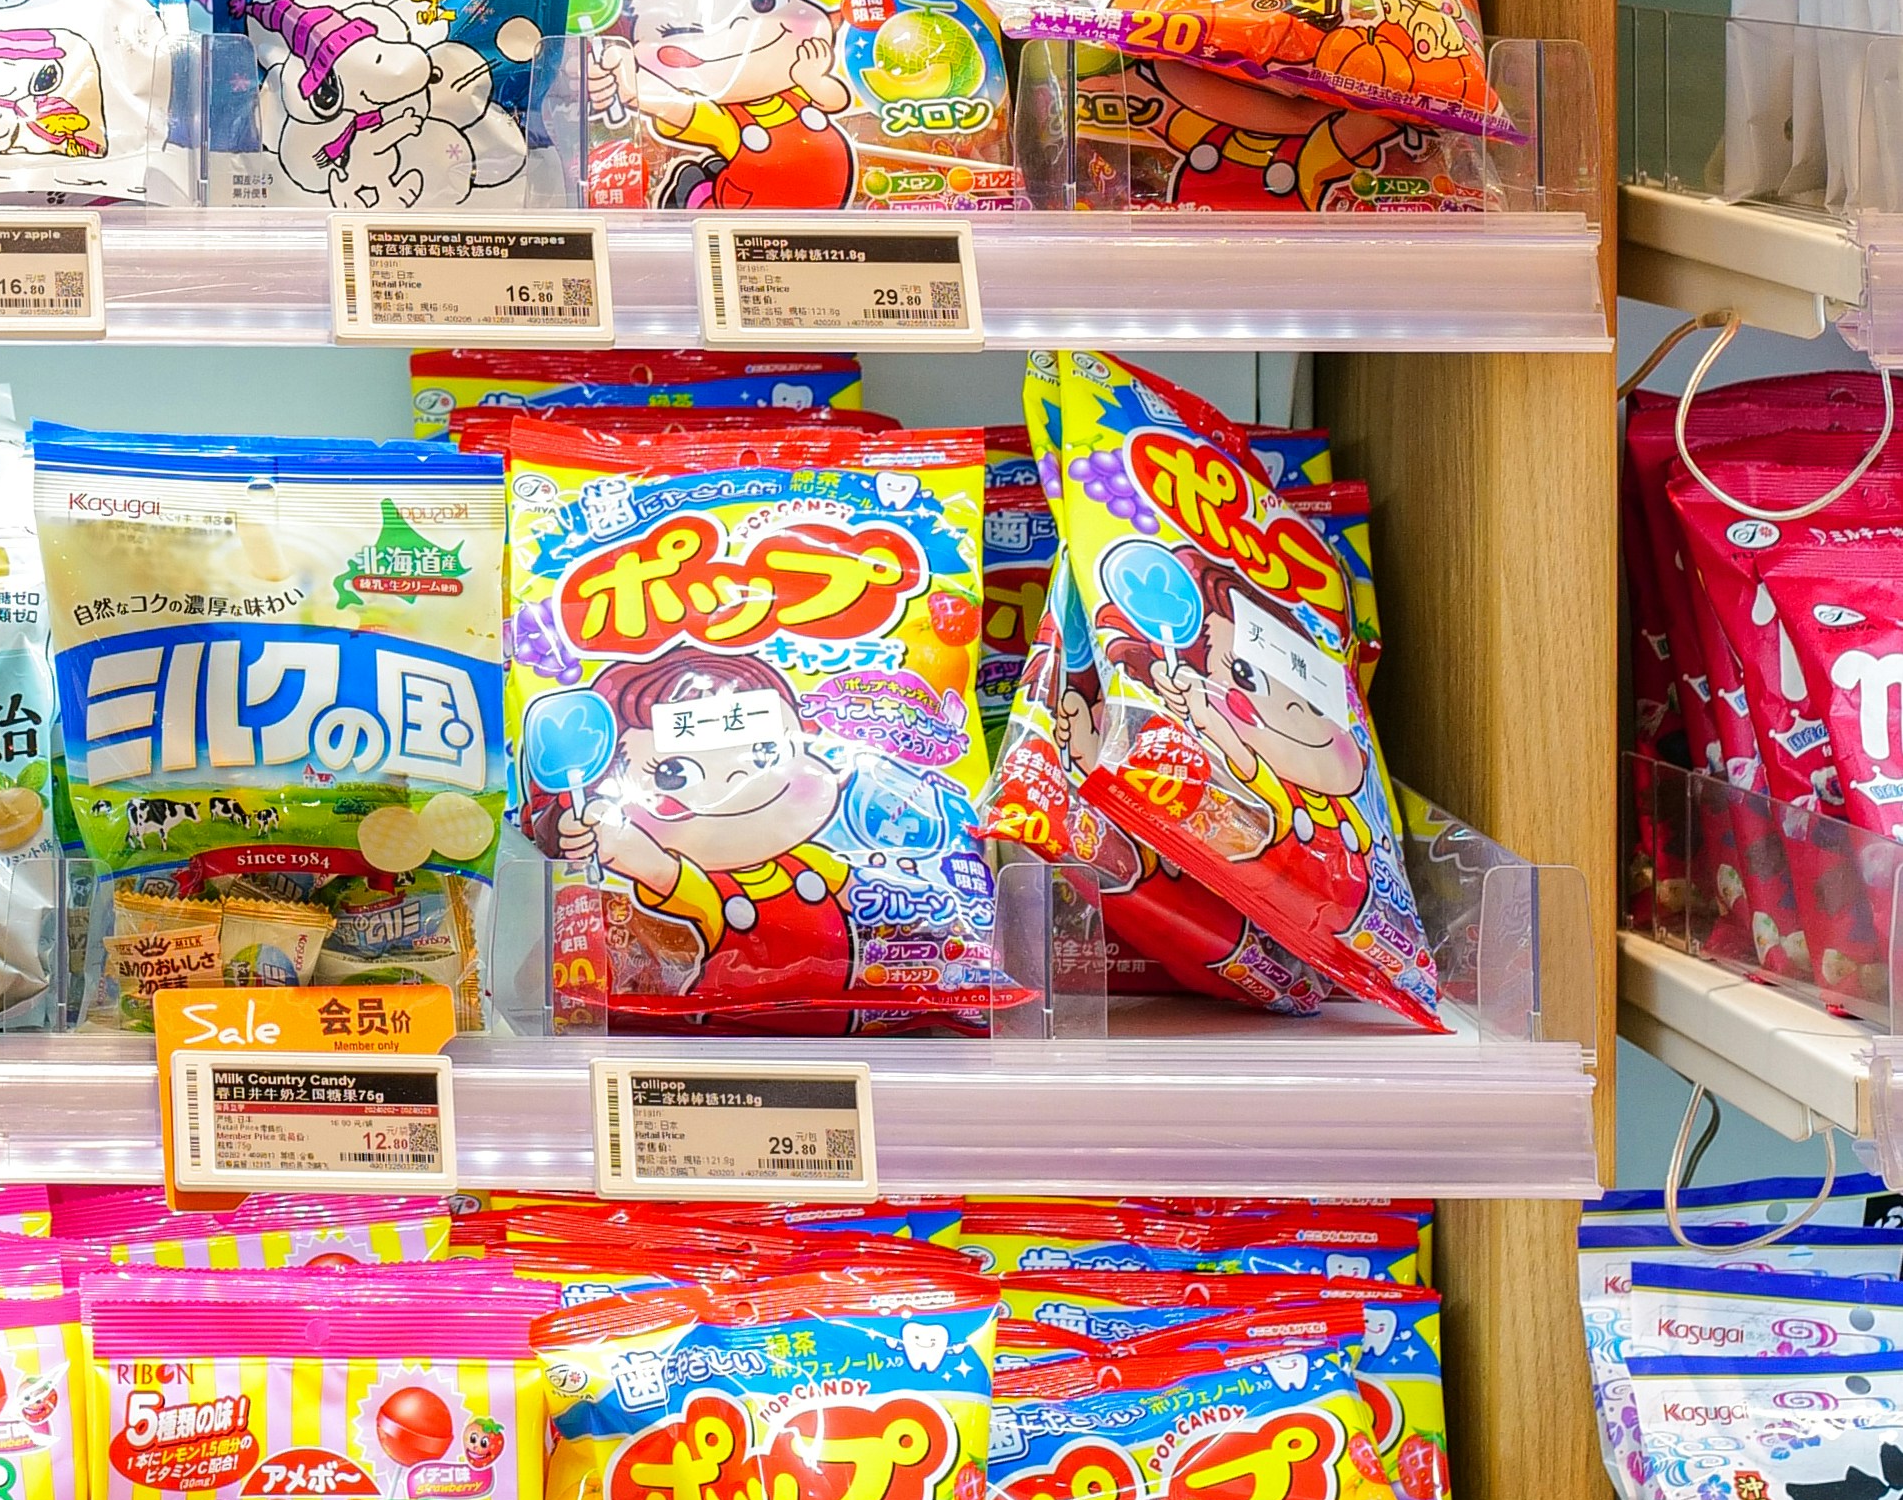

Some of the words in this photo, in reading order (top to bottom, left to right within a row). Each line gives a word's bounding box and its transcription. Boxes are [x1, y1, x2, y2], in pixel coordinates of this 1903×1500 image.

[873, 289, 922, 307] 29.80
[69, 492, 161, 519] Kasugai
[356, 547, 457, 577] 北海道産
[581, 531, 907, 646] ポップ
[73, 589, 305, 626] 自然なコクの濃厚な味わい
[765, 637, 907, 674] キャンディ
[1247, 620, 1327, 689] 买一赠一
[85, 641, 488, 792] ミルクの国
[672, 706, 770, 743] 买一送一
[236, 851, 283, 867] since
[289, 850, 331, 870] 1984
[183, 1002, 281, 1045] Sale
[317, 998, 411, 1035] 会员价
[214, 1073, 244, 1085] Milk
[247, 1073, 306, 1089] Country
[309, 1073, 357, 1089] Candy
[362, 1131, 409, 1151] 12.80
[1658, 1318, 1745, 1346] Kasugai
[1663, 1401, 1749, 1425] Kasugai
